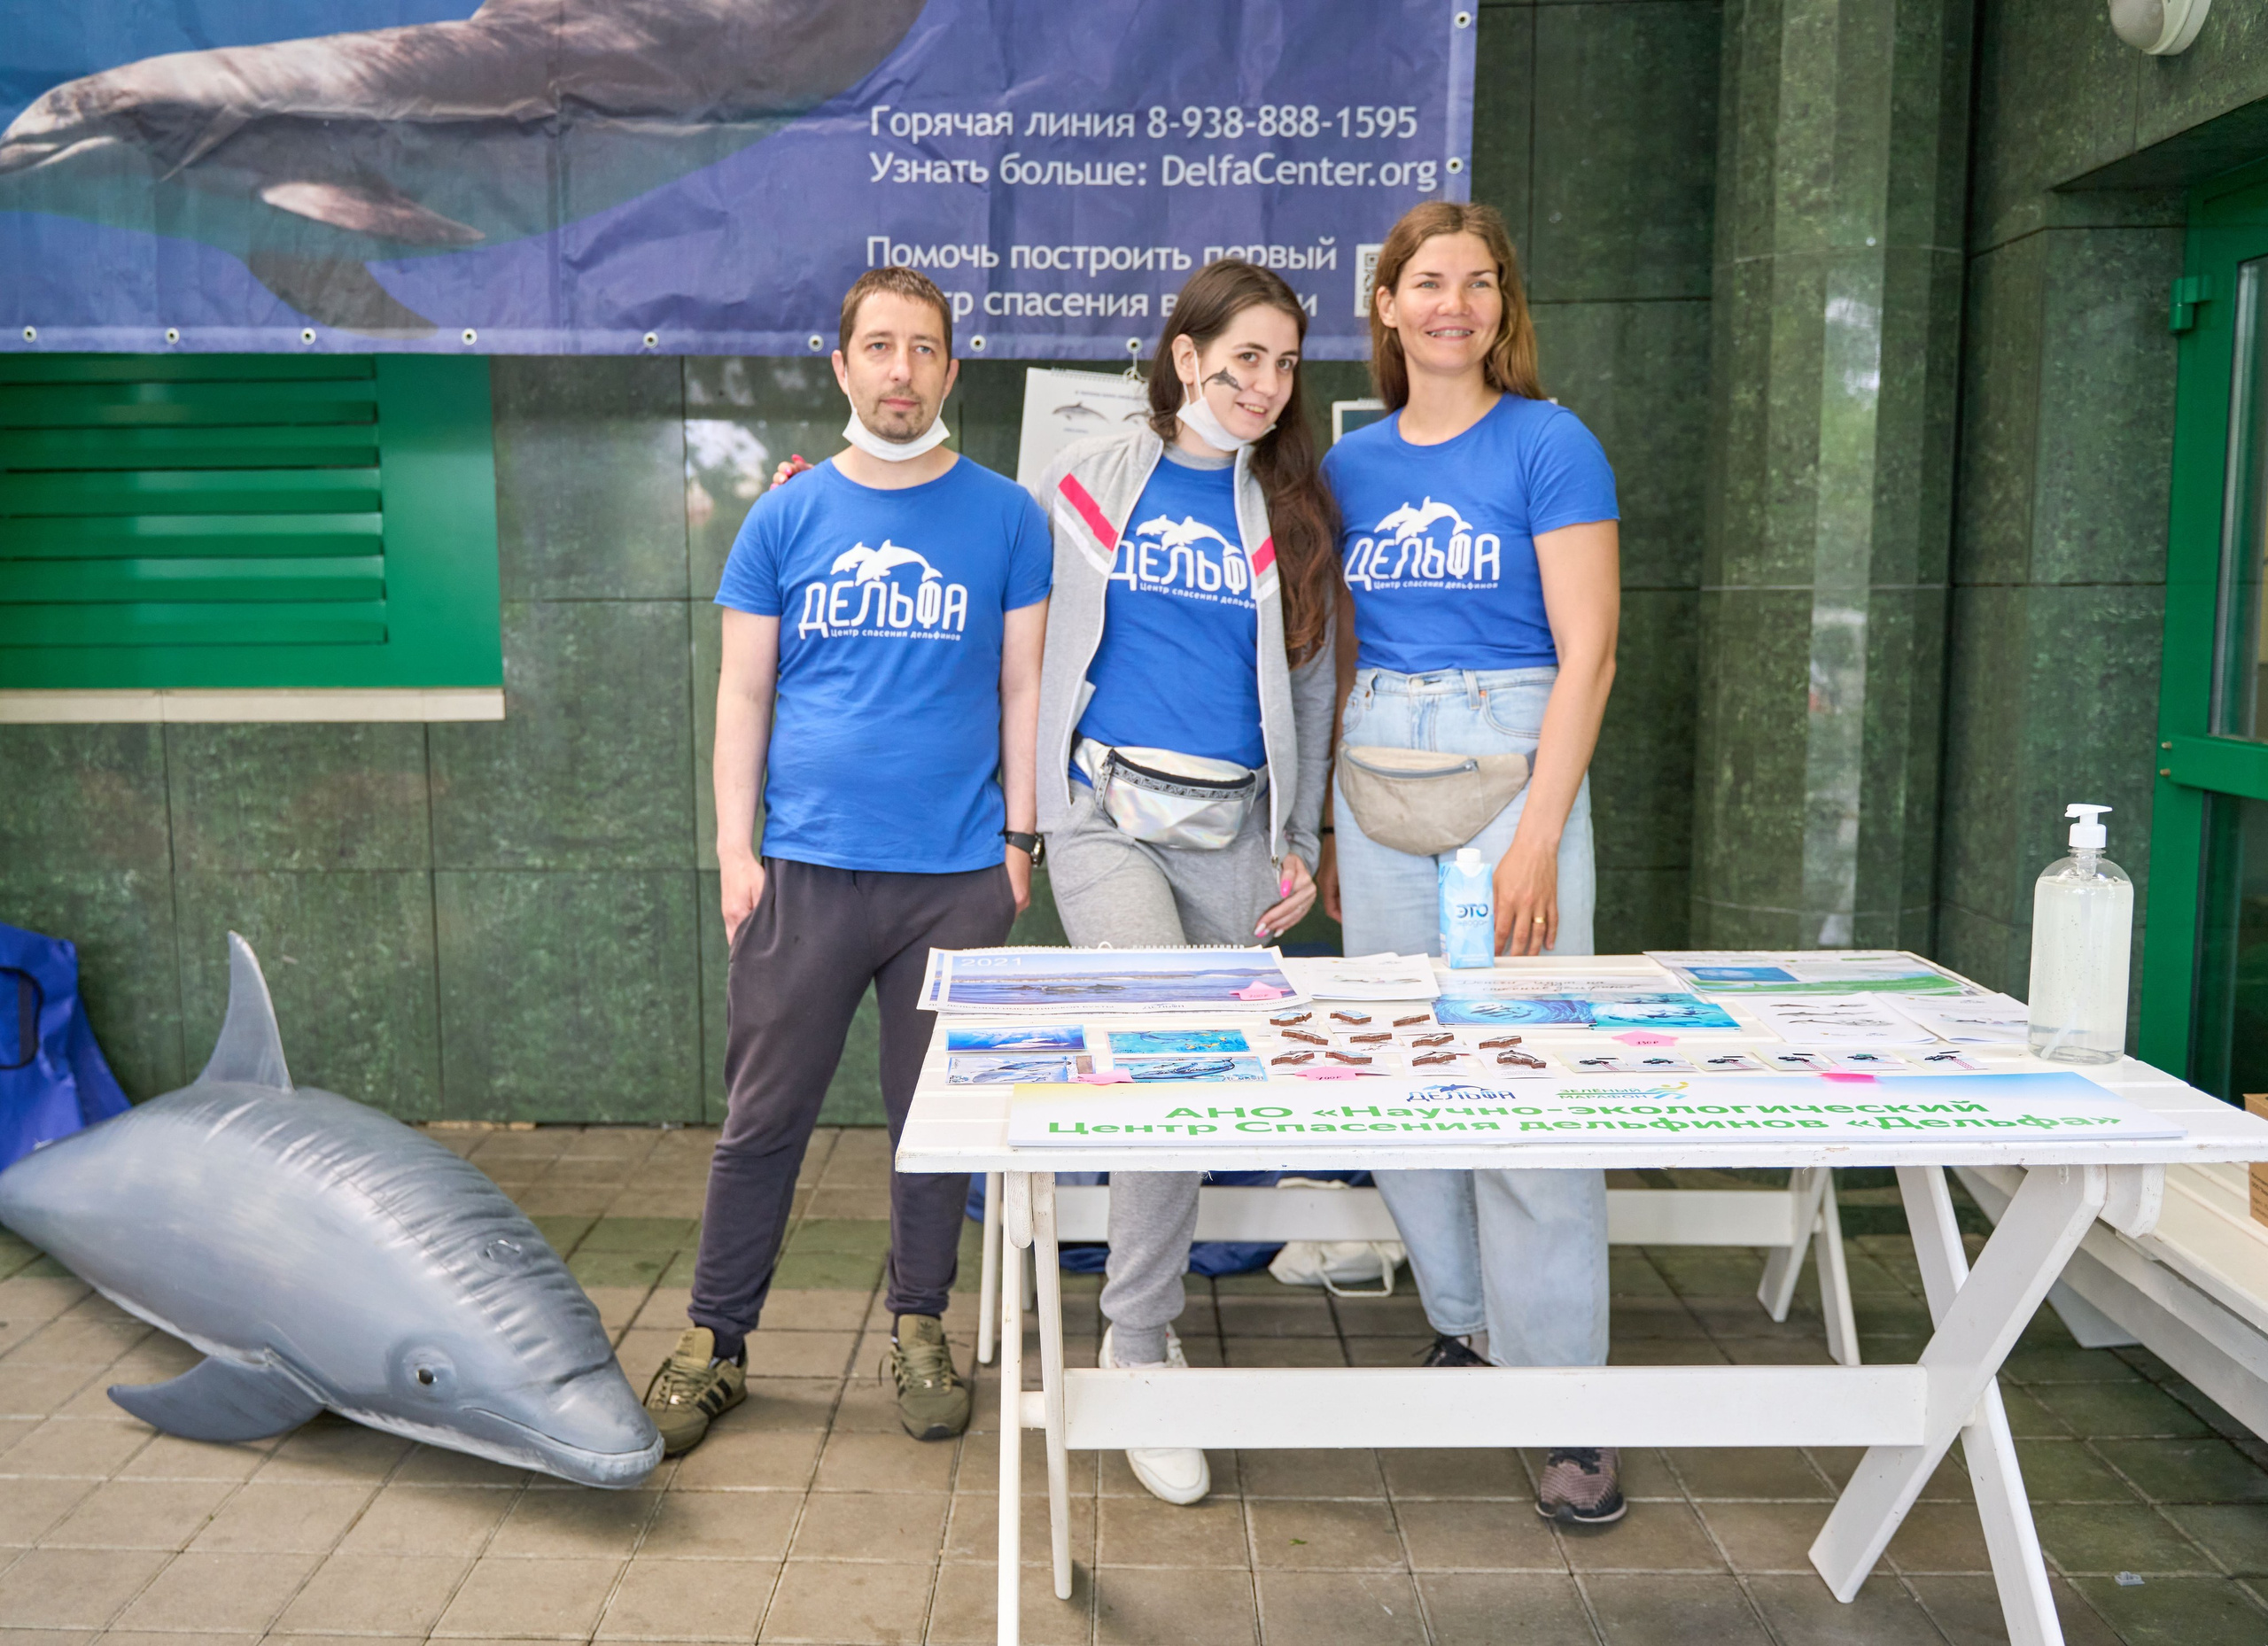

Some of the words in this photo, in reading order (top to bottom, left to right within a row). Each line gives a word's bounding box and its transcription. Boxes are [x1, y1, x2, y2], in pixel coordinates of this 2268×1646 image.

[870, 105, 1014, 144] Горячая
[1024, 112, 1135, 137] линия
[1146, 105, 1418, 139] 8-938-888-1595
[869, 151, 990, 183] Узнать
[999, 152, 1147, 186] больше:
[1161, 152, 1438, 192] DelfaCenter.org
[866, 236, 999, 268] Помочь
[1011, 245, 1192, 278] построить
[983, 291, 1149, 318] спасения
[1107, 540, 1256, 600] ДЕЛЬФ
[1343, 532, 1501, 592] ДЕЛЬФА
[1139, 582, 1170, 594] Центр
[1172, 587, 1218, 602] спасения
[1220, 595, 1257, 610] дельфи
[1373, 580, 1401, 590] Центр
[1445, 581, 1498, 591] дельфинов
[797, 579, 968, 641] ДЕЛЬФА
[830, 628, 859, 638] Центр
[861, 629, 908, 639] спасения
[910, 630, 961, 641] дельфинов
[1456, 903, 1488, 919] ЭТО
[960, 957, 1022, 967] 2021
[1165, 1106, 1294, 1120] АНО
[1312, 1099, 1989, 1120] «Научно-экологический
[1406, 1089, 1517, 1103] ДЕЛЬФА
[1048, 1122, 1218, 1136] Центр
[1234, 1120, 1502, 1133] Спасения
[1518, 1116, 1829, 1132] дельфинов
[1845, 1113, 2123, 1130] «Дельфа»
